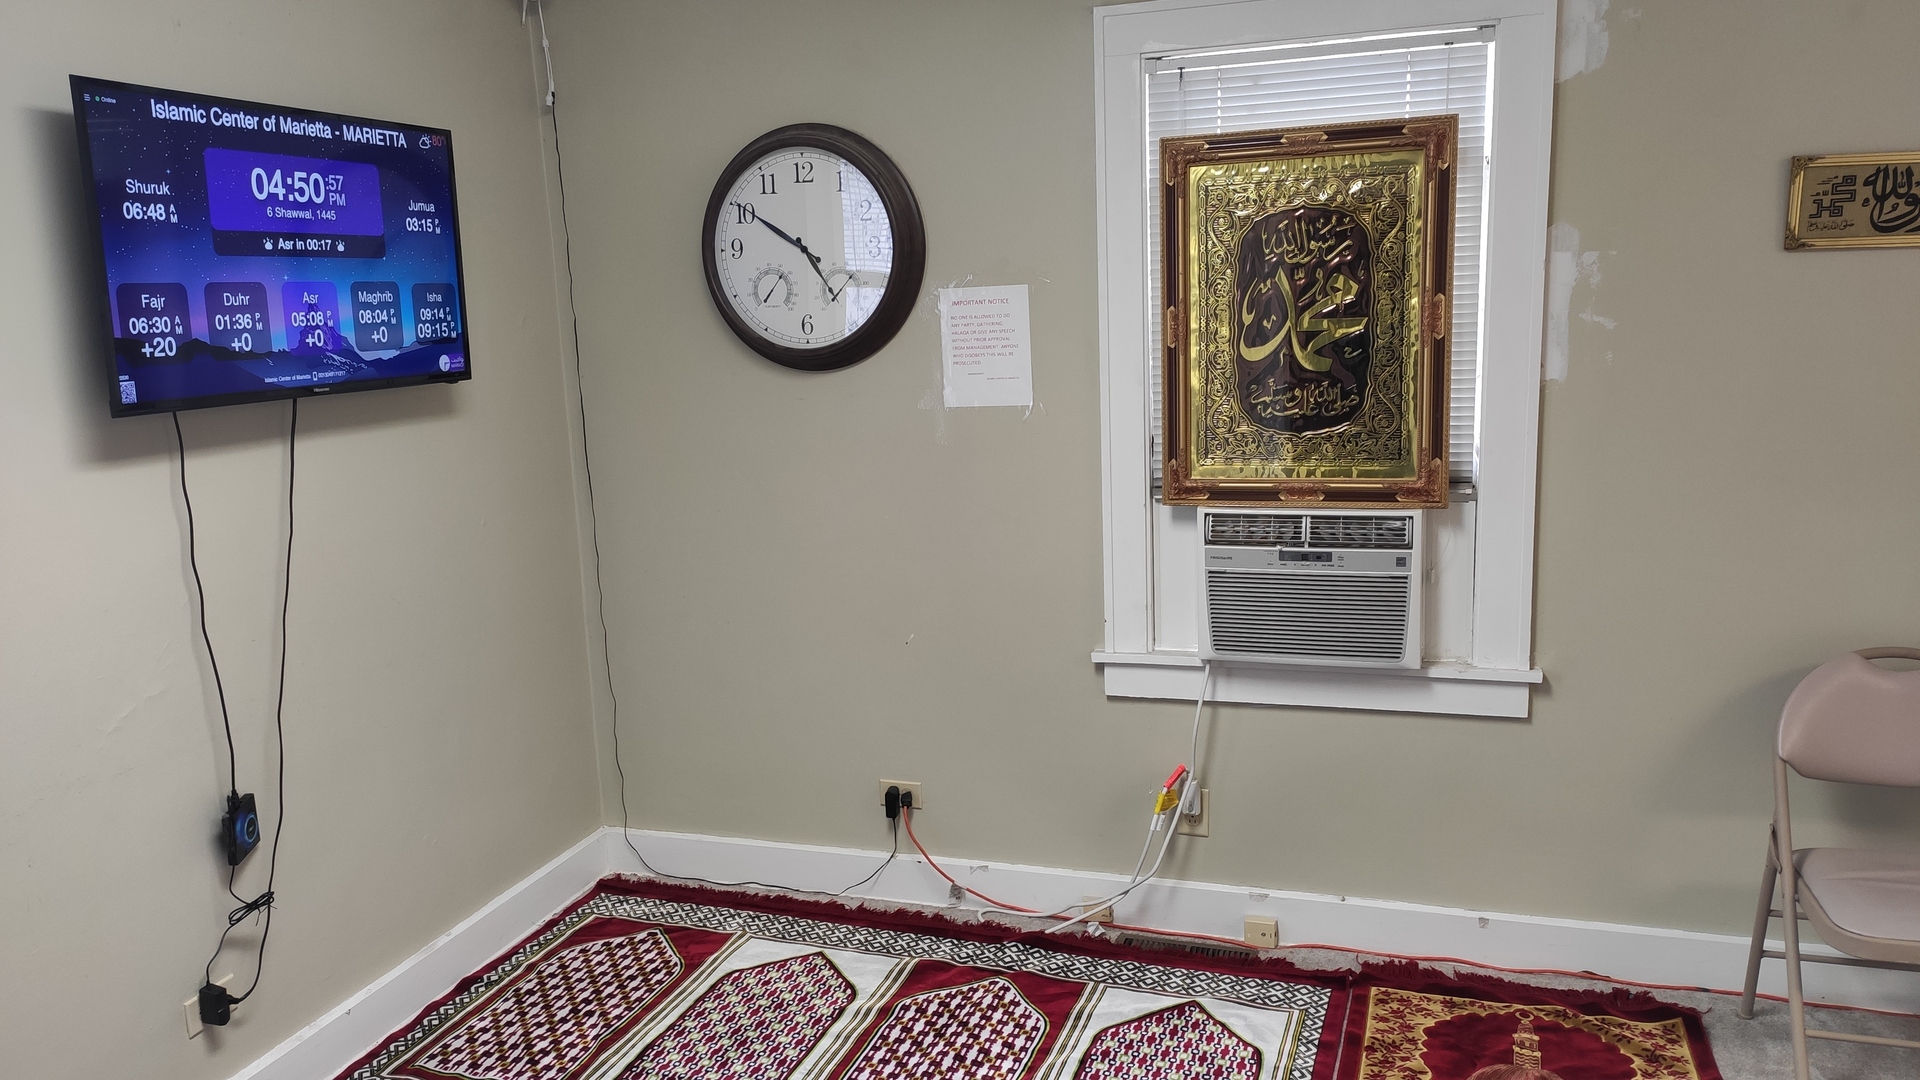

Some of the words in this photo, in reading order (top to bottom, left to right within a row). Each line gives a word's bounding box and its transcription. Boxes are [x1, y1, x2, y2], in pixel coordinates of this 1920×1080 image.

[150, 98, 206, 124] Islamic
[210, 106, 259, 130] Center
[262, 114, 276, 132] of
[280, 116, 332, 139] Marietta
[342, 124, 407, 148] MARIETTA
[792, 161, 814, 184] 12
[836, 170, 846, 192] 1
[126, 178, 170, 196] Shuruk
[759, 172, 778, 195] 11
[329, 192, 346, 206] PM
[408, 199, 436, 212] Jumua
[122, 202, 166, 220] 06:48
[267, 206, 273, 218] 6
[275, 208, 315, 220] Shawwal,
[316, 210, 336, 220] 1445
[736, 202, 755, 224] 10
[860, 200, 872, 222] 2
[406, 217, 433, 232] 03:15
[278, 238, 294, 250] Asr
[296, 238, 304, 250] in
[306, 239, 332, 250] 00:17
[731, 238, 744, 260] 9
[868, 236, 882, 258] 3
[141, 294, 166, 311] Fajr
[223, 292, 250, 306] Duhr
[302, 292, 318, 304] Asr
[358, 290, 394, 306] Maghrib
[426, 292, 442, 302] Isha
[215, 314, 253, 330] 01:36
[291, 311, 324, 327] 05:08
[358, 309, 388, 324] 08:04
[420, 308, 445, 321] 09:14
[128, 316, 171, 335] 06:30
[417, 322, 449, 338] 09:15
[801, 314, 814, 336] 6
[231, 332, 252, 352] +0
[305, 329, 324, 348] +0
[371, 326, 388, 343] +0
[141, 336, 178, 358] +20
